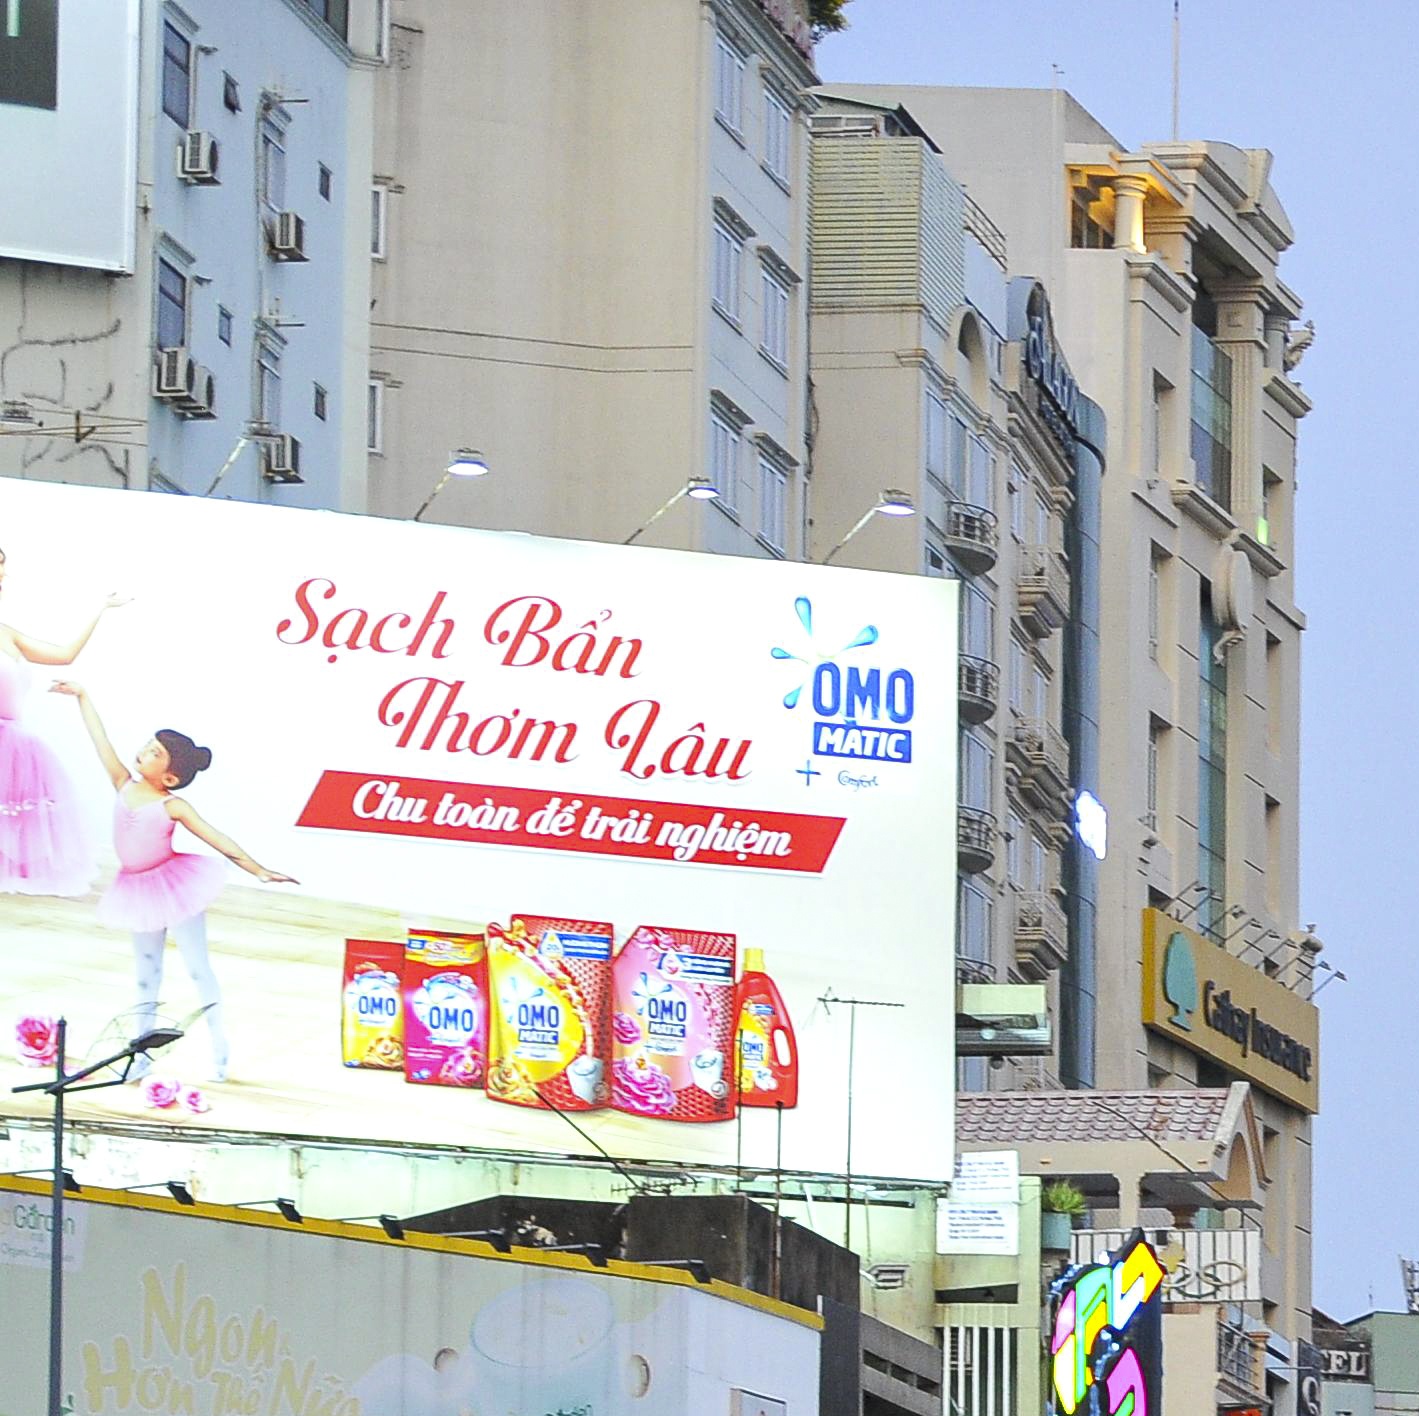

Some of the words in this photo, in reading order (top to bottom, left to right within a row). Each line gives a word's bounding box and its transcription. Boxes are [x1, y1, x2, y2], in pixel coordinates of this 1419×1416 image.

[276, 577, 456, 664] Sạch
[483, 595, 643, 679] Bẩn
[812, 661, 915, 725] OMO
[377, 676, 579, 764] Thơm
[602, 699, 753, 780] Lâu
[818, 725, 908, 760] MATIC
[351, 779, 428, 824] Chu
[433, 795, 520, 833] toàn
[525, 797, 578, 836] để
[581, 807, 651, 847] trải
[655, 811, 793, 862] nghiệm
[358, 996, 397, 1018] OMO
[429, 1005, 475, 1032] OMO
[518, 1003, 560, 1029] OMO
[648, 996, 687, 1023] OMO
[142, 1262, 279, 1379] Ngon
[82, 1335, 195, 1415] Hơn
